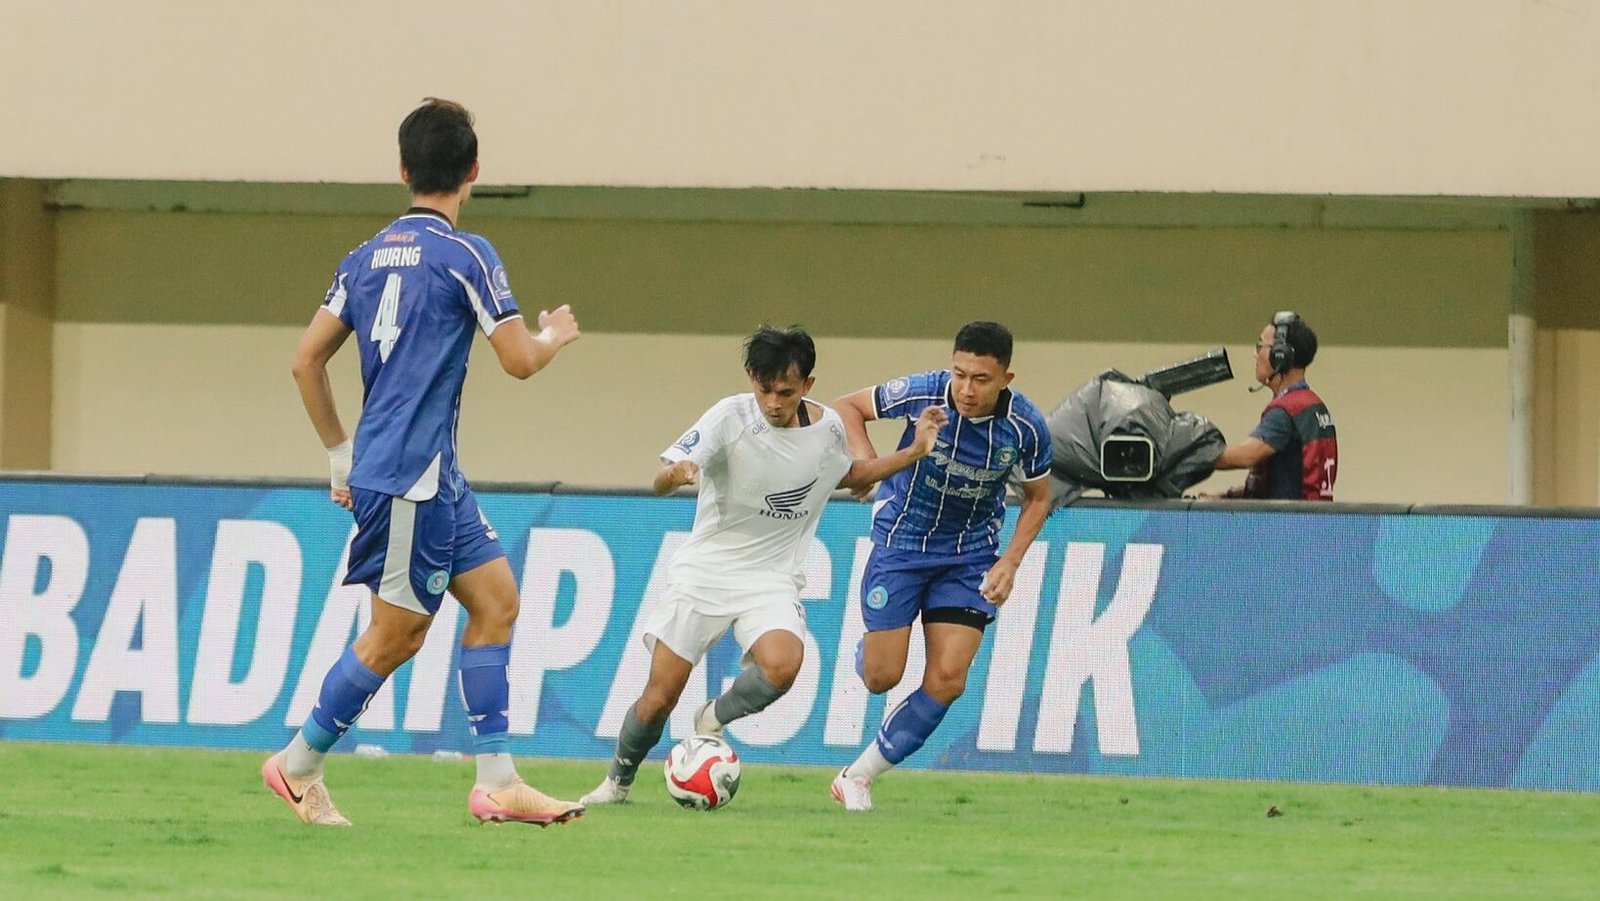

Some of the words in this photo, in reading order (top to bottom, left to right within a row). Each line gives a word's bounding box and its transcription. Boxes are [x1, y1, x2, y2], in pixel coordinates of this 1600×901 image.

[371, 246, 422, 270] HWANG
[370, 273, 402, 363] 4
[759, 509, 809, 520] HONDA
[0, 514, 467, 731] BADAI
